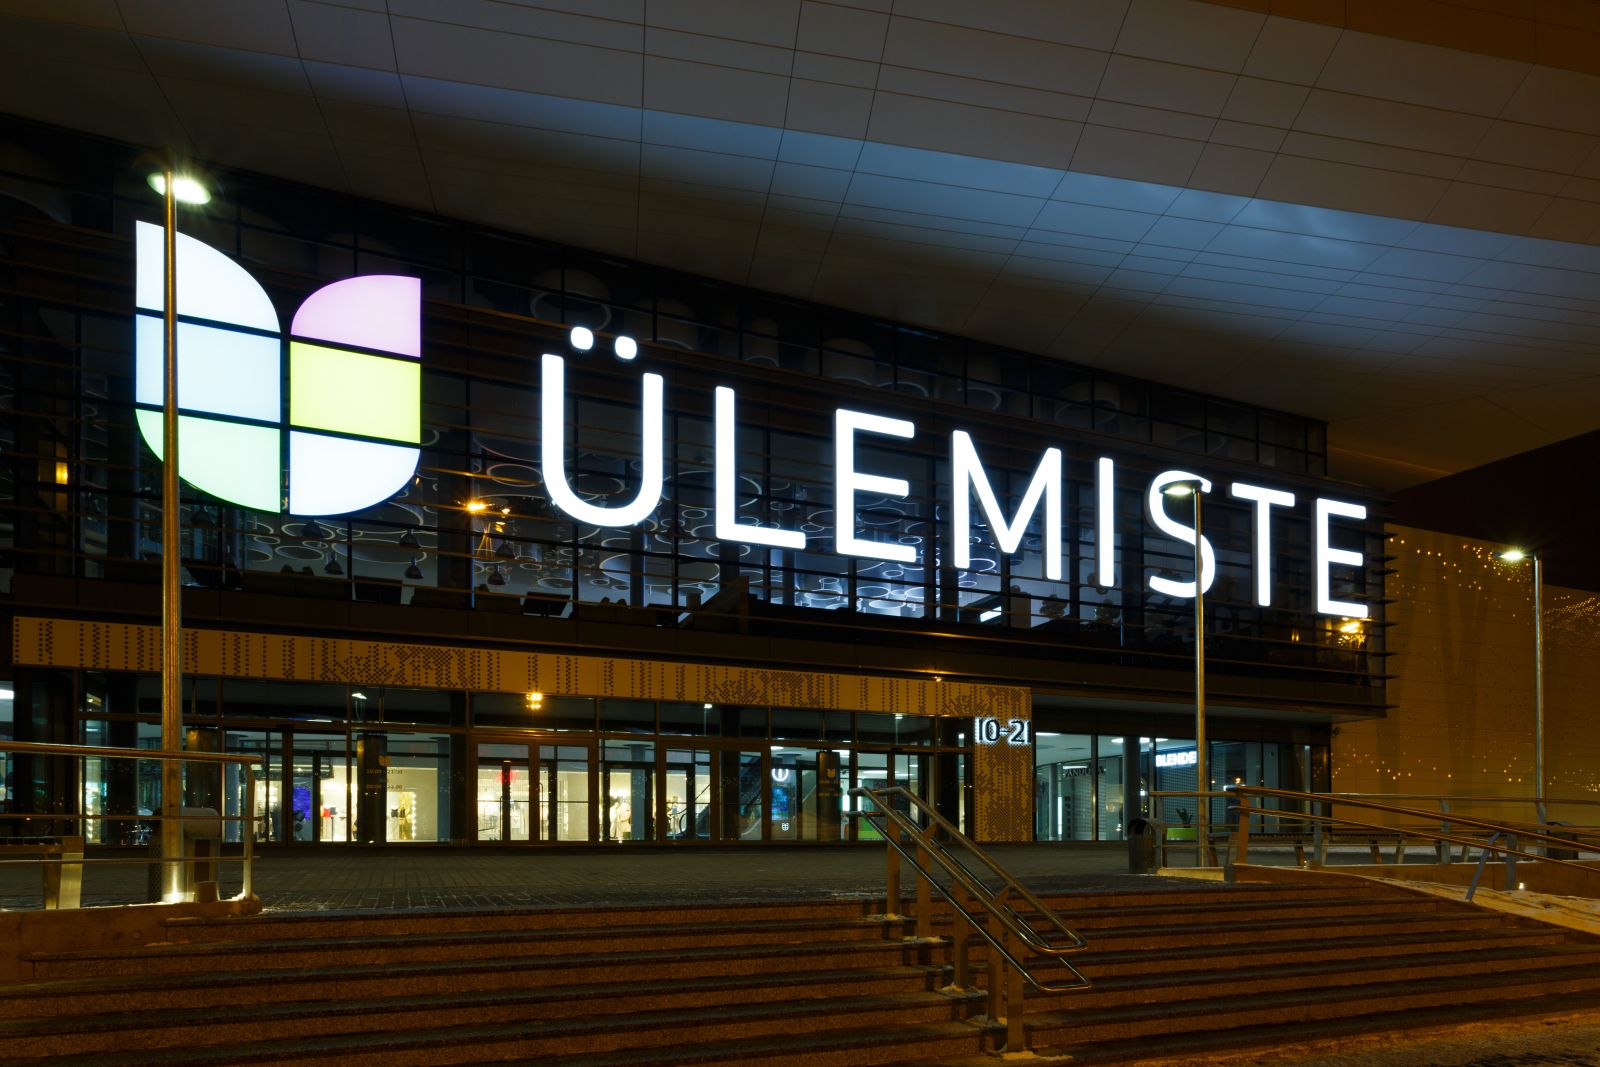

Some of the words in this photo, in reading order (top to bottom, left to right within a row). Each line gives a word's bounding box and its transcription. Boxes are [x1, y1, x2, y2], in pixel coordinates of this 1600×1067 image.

[540, 326, 1369, 620] ÜLEMISTE
[977, 717, 1032, 743] 10-21
[1064, 765, 1106, 777] PANDOA
